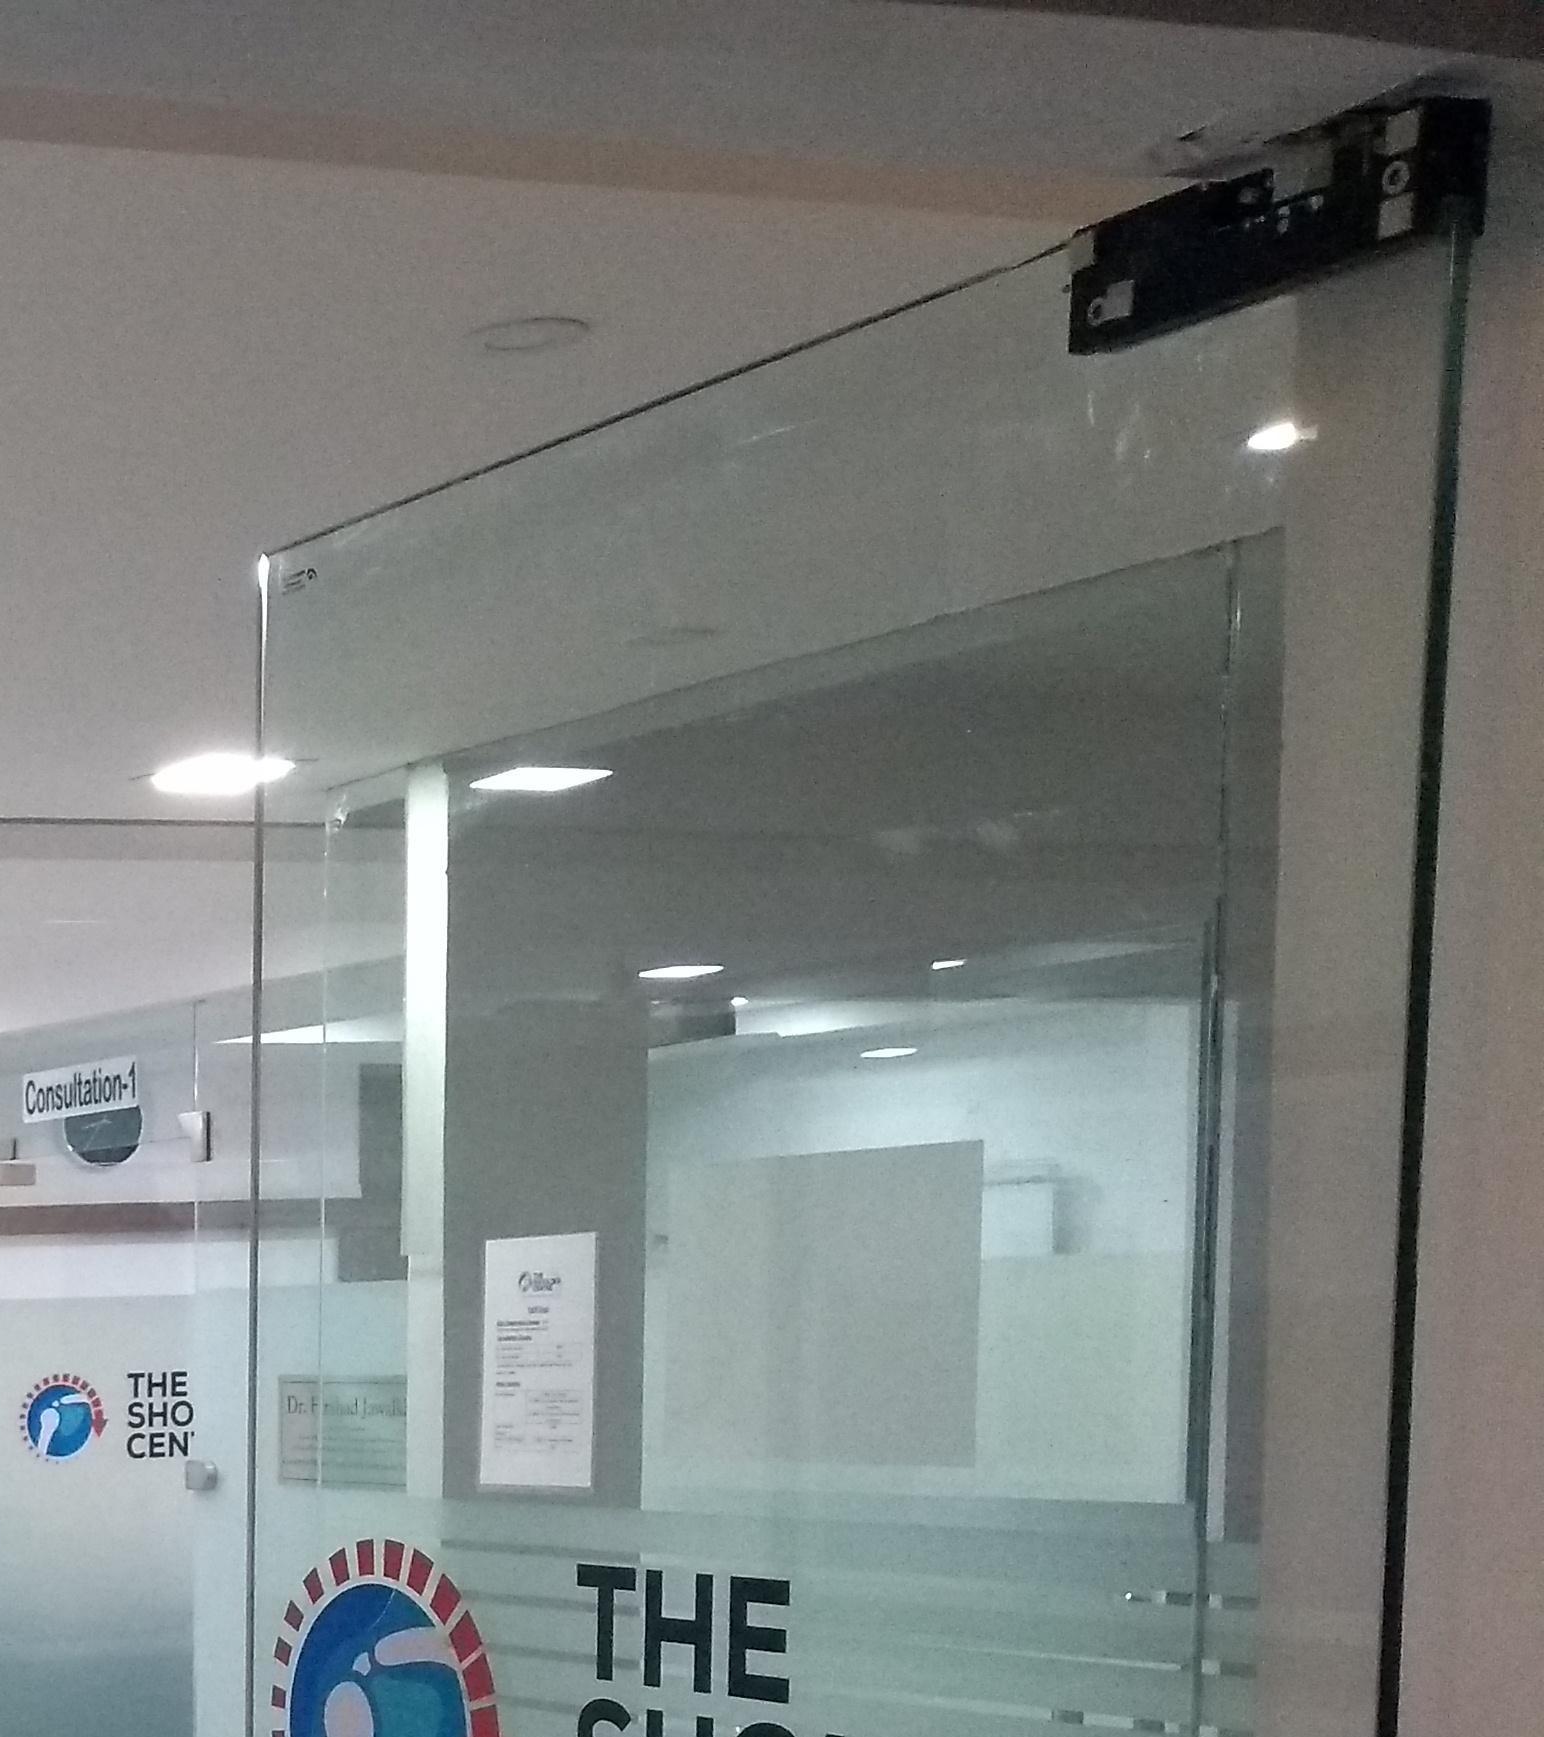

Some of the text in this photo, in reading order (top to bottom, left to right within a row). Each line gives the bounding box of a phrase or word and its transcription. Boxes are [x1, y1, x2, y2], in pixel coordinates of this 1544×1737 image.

[24, 1060, 137, 1116] Consultation-1
[126, 1371, 188, 1398] THE
[126, 1431, 195, 1459] CEN
[576, 1563, 791, 1704] THE
